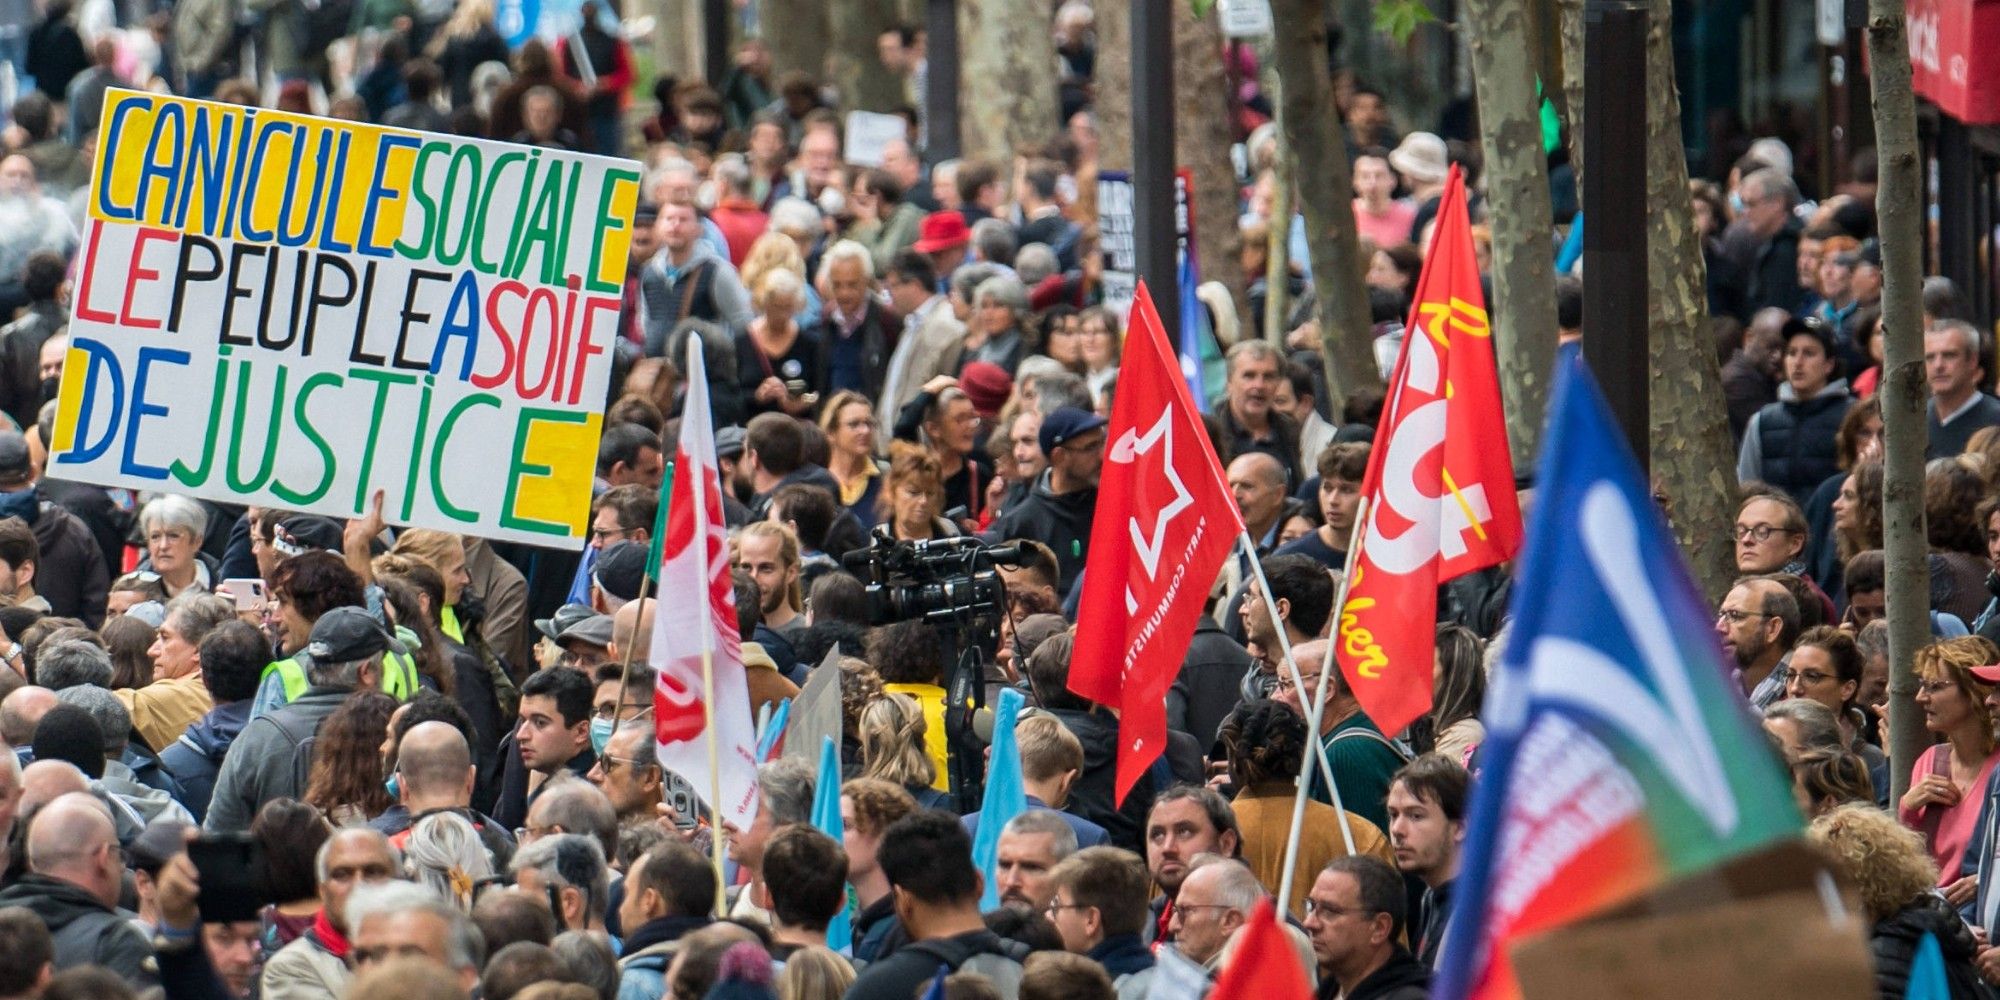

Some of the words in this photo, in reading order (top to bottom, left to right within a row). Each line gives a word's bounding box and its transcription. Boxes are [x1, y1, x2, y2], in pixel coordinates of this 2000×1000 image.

[76, 218, 181, 329] LE
[167, 235, 453, 371] PEUPLE
[429, 269, 481, 383] A
[56, 337, 192, 480] DE
